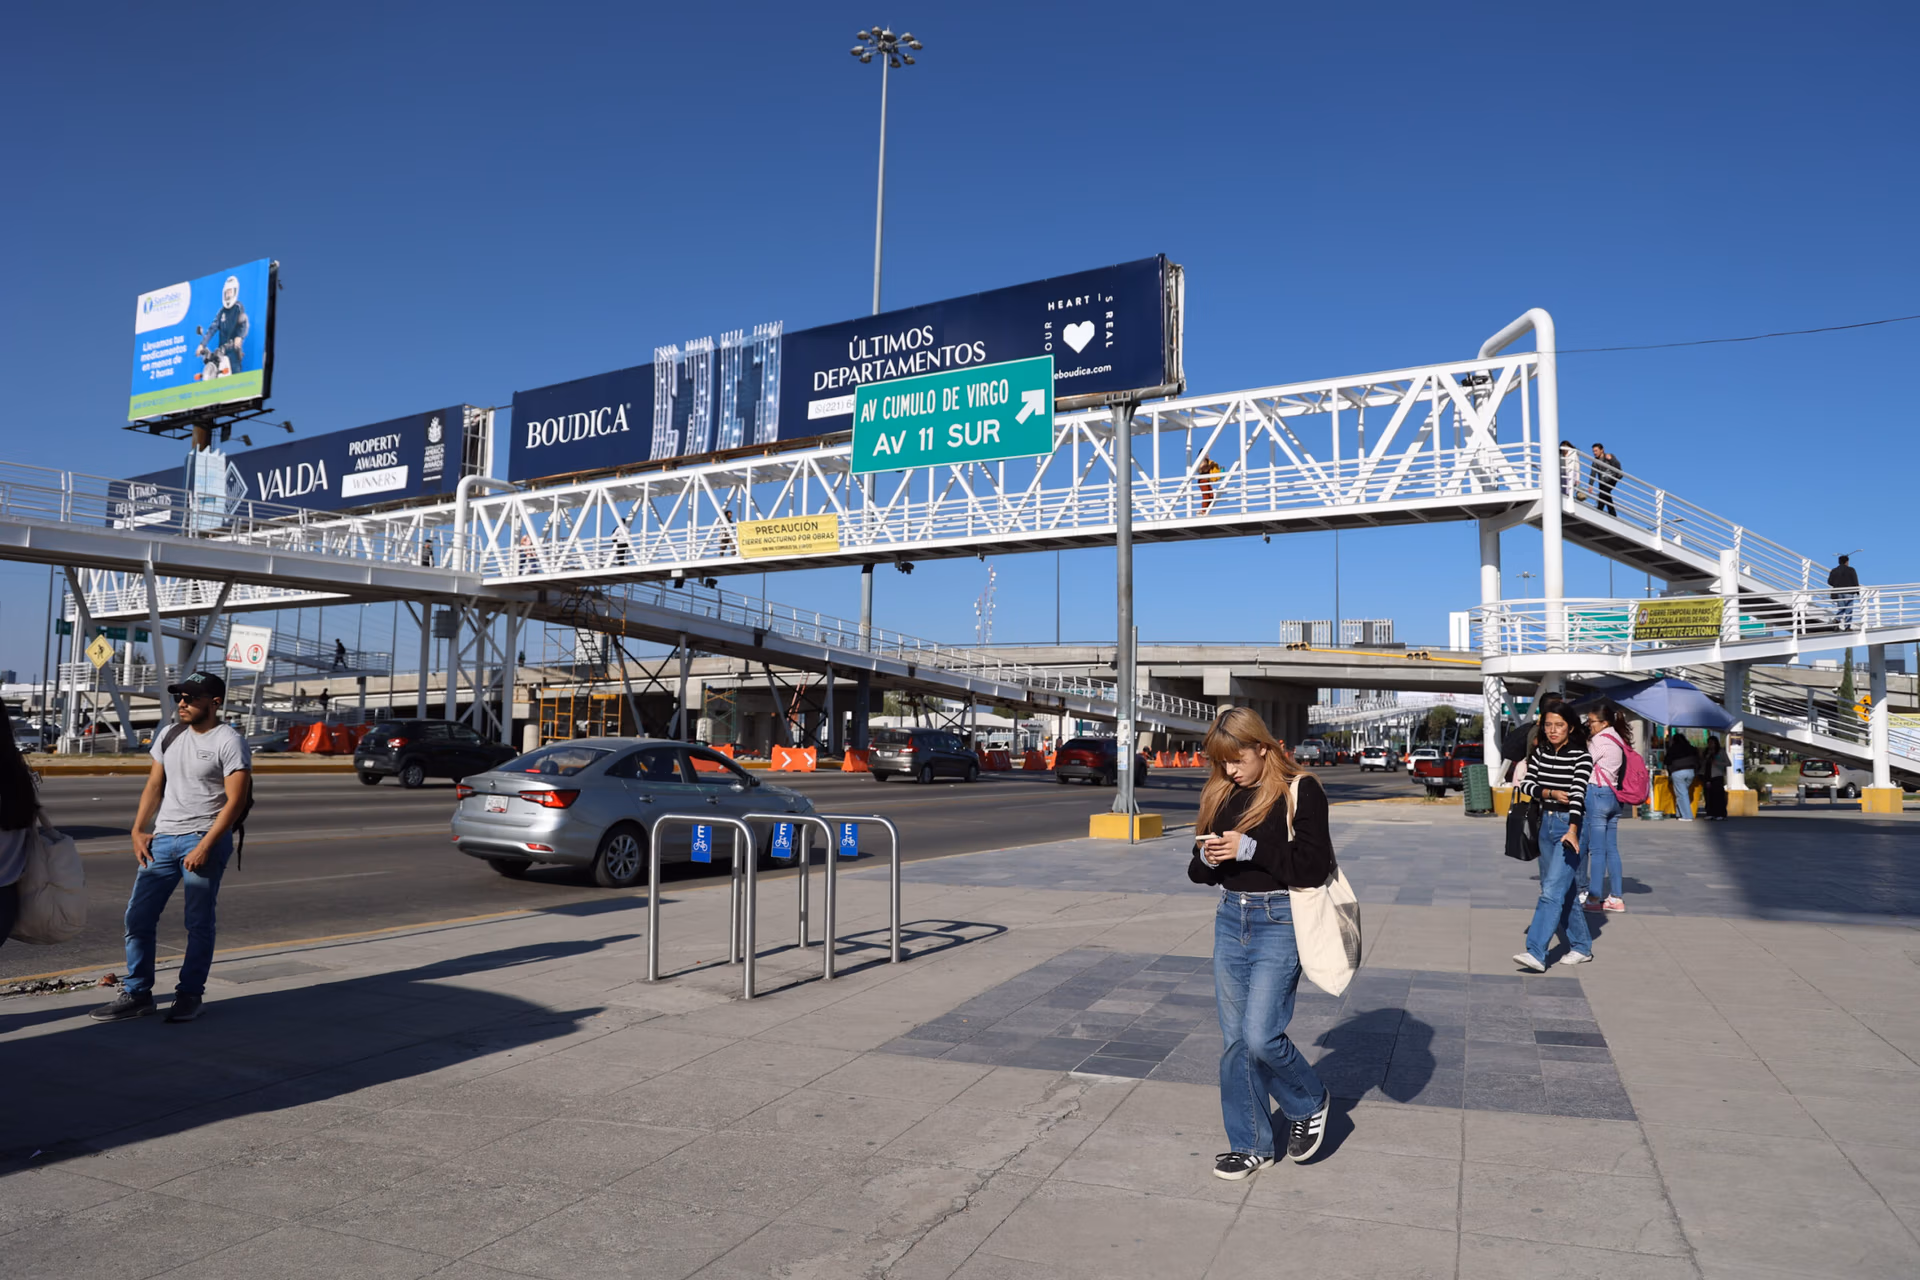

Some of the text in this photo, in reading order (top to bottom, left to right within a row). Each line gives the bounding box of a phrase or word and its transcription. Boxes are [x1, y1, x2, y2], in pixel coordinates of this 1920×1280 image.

[1047, 295, 1090, 311] HEART
[1044, 322, 1053, 351] OUR
[1105, 311, 1114, 348] REAL
[848, 325, 934, 361] ÚLTIMOS
[140, 344, 188, 362] medicamentos
[150, 358, 172, 369] menos
[814, 341, 986, 392] DEPARTAMENTOS
[156, 368, 174, 378] horas
[860, 378, 1009, 423] AV CUMULO DE VIRGO
[526, 403, 630, 449] BOUDICA
[348, 432, 402, 456] PROPERTY
[872, 418, 1001, 457] AV 11 SUR
[354, 450, 398, 472] AWARDS
[257, 458, 328, 502] VALDA
[352, 472, 397, 489] WINNERS
[755, 519, 818, 535] PRECAUCIÓN
[742, 532, 835, 546] CIERRE NOCTURNO POR OBRAS
[1650, 608, 1666, 616] CIERRE
[1666, 608, 1692, 616] TEMPORAL
[1692, 608, 1698, 616] DE
[1658, 626, 1684, 638] PUENTE
[698, 825, 705, 838] E
[780, 823, 788, 835] E
[845, 822, 852, 835] E
